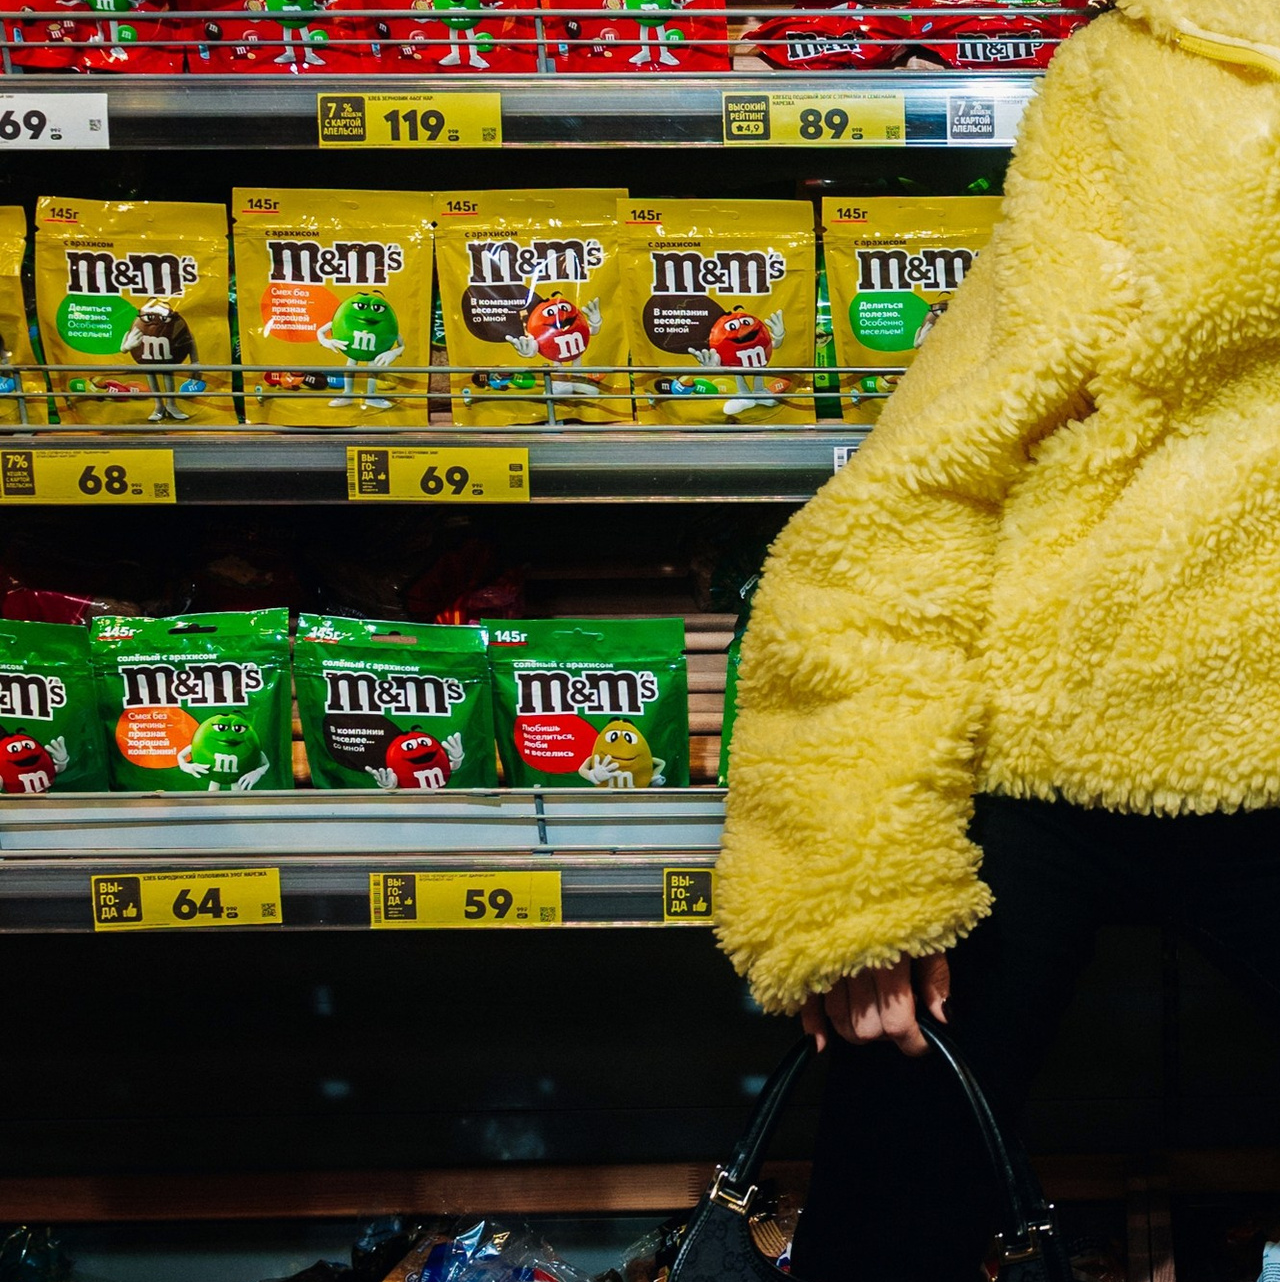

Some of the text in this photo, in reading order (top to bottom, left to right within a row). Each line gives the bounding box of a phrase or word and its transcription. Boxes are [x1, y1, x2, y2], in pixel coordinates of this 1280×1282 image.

[328, 103, 336, 116] 7
[728, 102, 766, 112] ВЫСОКИЙ
[957, 101, 966, 115] 7
[730, 111, 764, 121] РЕЙТИНГ
[961, 115, 991, 125] КАРТОЙ
[332, 117, 361, 127] КАРТОЙ
[383, 109, 445, 141] 119
[800, 109, 849, 140] 89
[324, 127, 363, 135] АПЕЛЬСИН
[952, 124, 993, 134] АПЕЛЬСИН
[248, 199, 279, 210] 145г
[447, 201, 478, 212] 145г
[50, 208, 79, 219] 145г
[631, 210, 662, 221] 145г
[837, 208, 868, 219] 145г
[267, 241, 403, 285] m&m's
[466, 239, 603, 285] m&m's
[66, 251, 198, 296] m&m's
[650, 251, 786, 296] m&m's
[859, 302, 903, 310] Делиться
[860, 327, 904, 335] весельем!
[6, 455, 28, 468] 7%
[362, 454, 378, 462] ВЫ-
[362, 463, 375, 471] ГО-
[78, 465, 128, 495] 68
[362, 472, 374, 480] ДА
[420, 466, 469, 495] 69
[104, 626, 135, 638] 145г
[495, 630, 528, 643] 145г
[118, 662, 263, 709] m&m's
[323, 670, 466, 717] m&m's
[516, 670, 658, 716] m&m's
[157, 873, 195, 881] БОРОДИНСКИЙ
[387, 878, 405, 887] ВЫ-
[671, 876, 694, 887] ВЫ-
[99, 882, 123, 894] ВЫ-
[387, 888, 402, 896] ГО-
[671, 888, 690, 900] ГО-
[100, 895, 119, 906] ГО-
[172, 888, 224, 920] 64
[387, 896, 401, 906] ДА
[464, 888, 513, 919] 59
[671, 900, 688, 913] ДА
[101, 907, 118, 919] ДА
